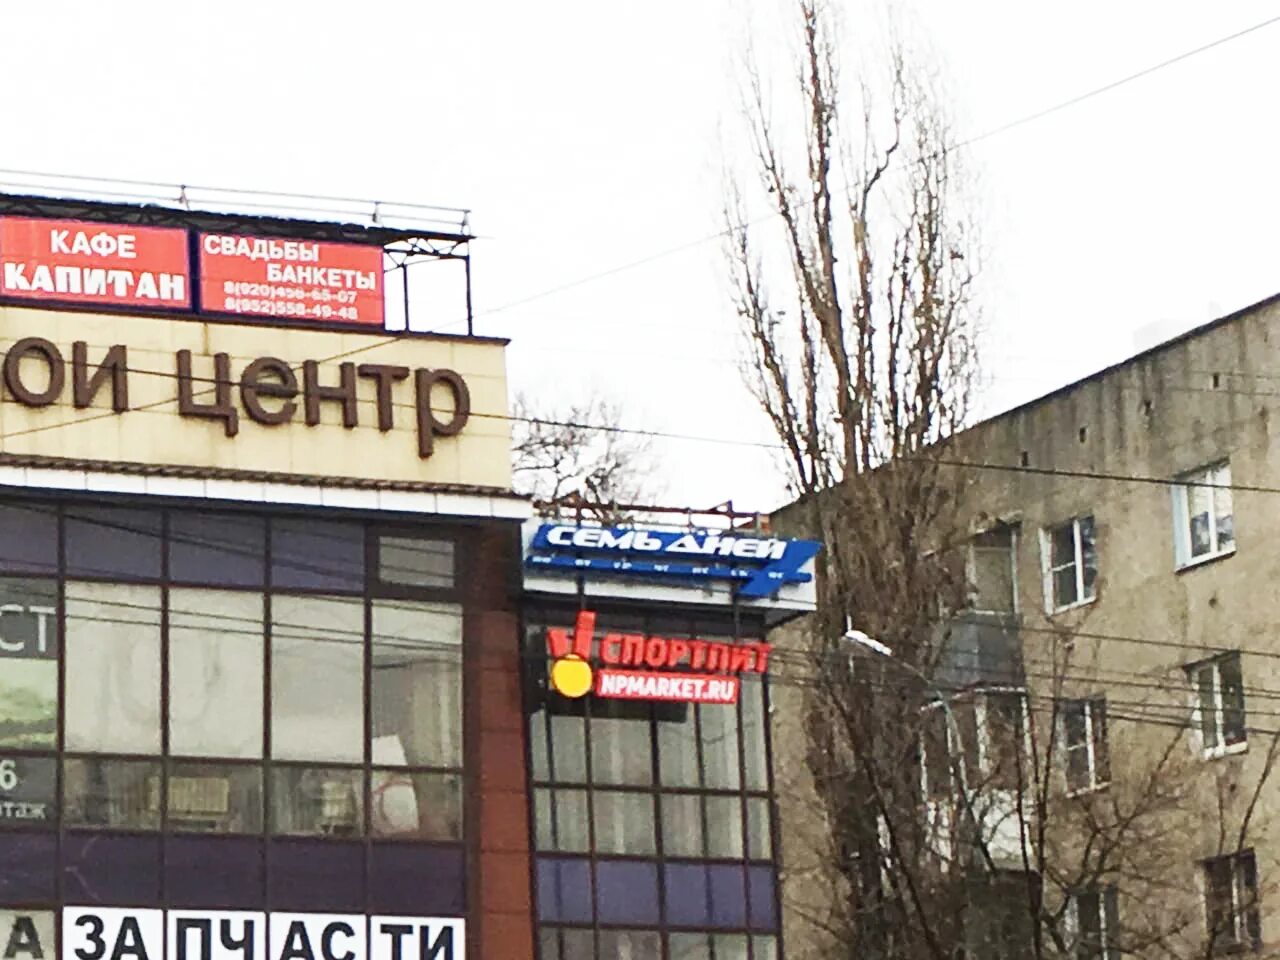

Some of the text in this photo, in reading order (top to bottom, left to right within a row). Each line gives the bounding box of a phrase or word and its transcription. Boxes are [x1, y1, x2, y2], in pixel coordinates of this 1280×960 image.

[51, 230, 136, 258] КАФЕ
[204, 235, 319, 262] СВАДЬБЫ
[4, 262, 185, 300] КАПИТАН
[267, 264, 376, 290] БАНКЕТЫ
[546, 526, 663, 551] СЕМЬ
[599, 632, 773, 673] СПОРТПИТ
[601, 674, 735, 700] NPMARKET.RU
